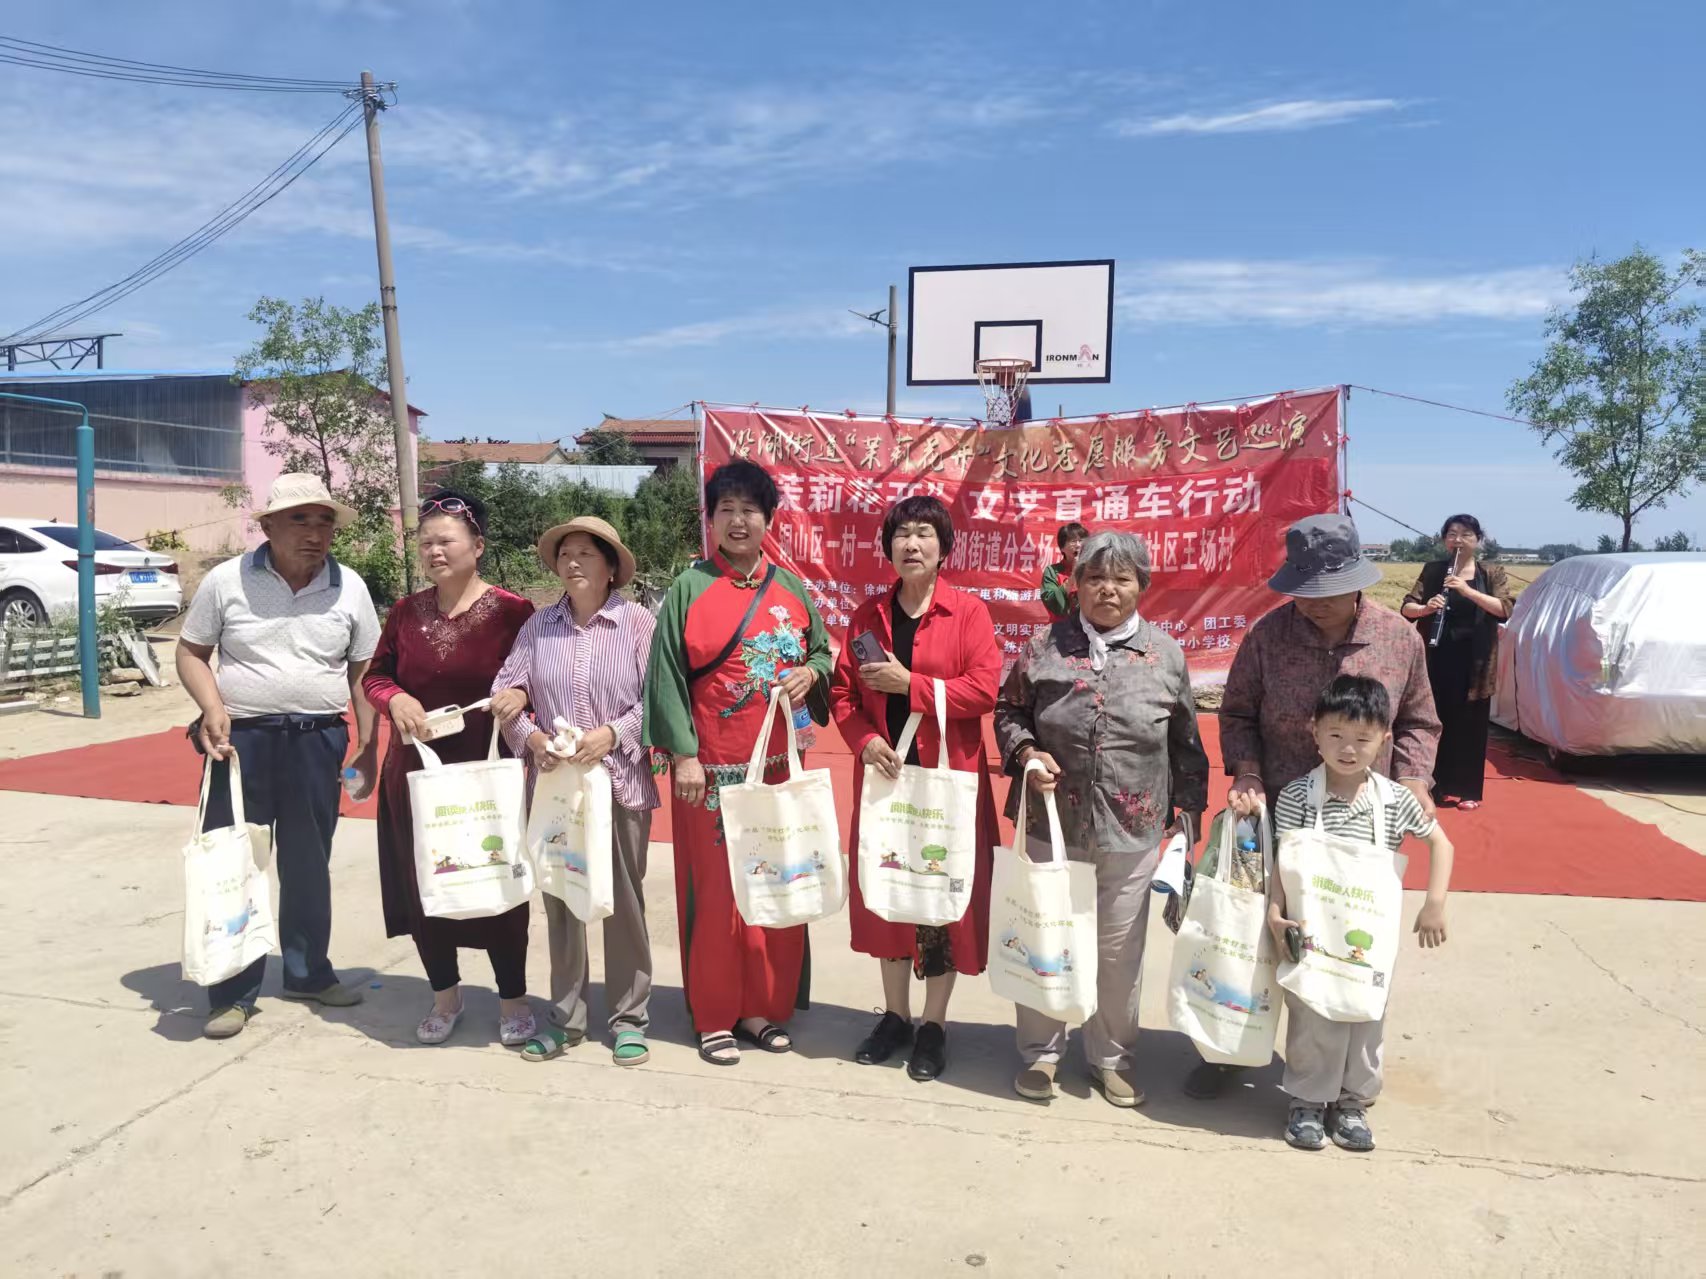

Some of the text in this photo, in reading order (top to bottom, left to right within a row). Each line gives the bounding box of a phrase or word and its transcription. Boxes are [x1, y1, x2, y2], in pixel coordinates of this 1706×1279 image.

[1045, 344, 1100, 362] IRONMAN
[939, 529, 1063, 573] 湖街道分会场
[1133, 525, 1236, 574] 社区王场村
